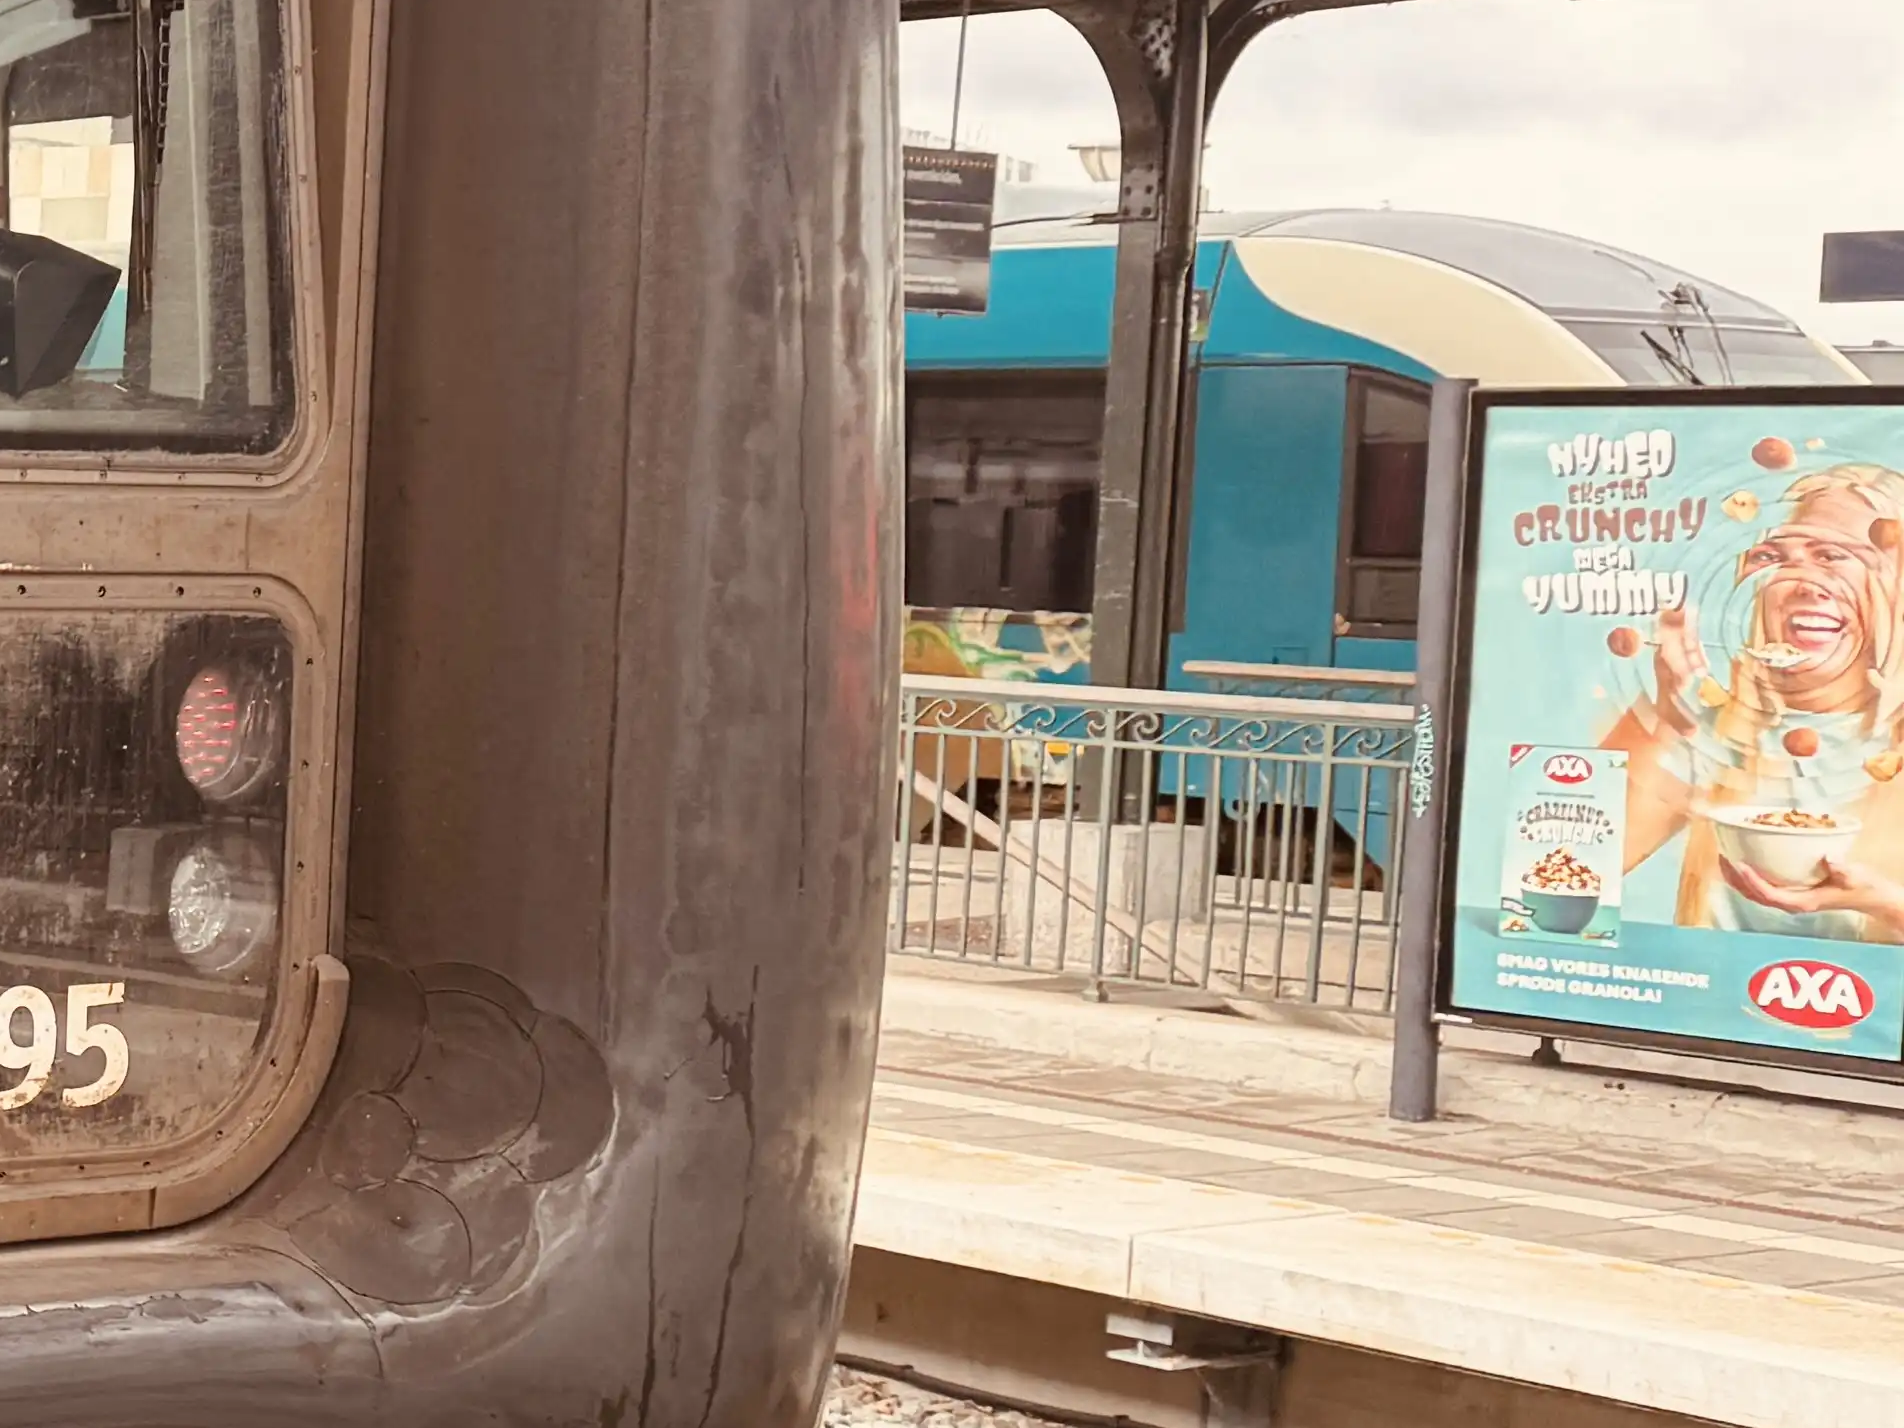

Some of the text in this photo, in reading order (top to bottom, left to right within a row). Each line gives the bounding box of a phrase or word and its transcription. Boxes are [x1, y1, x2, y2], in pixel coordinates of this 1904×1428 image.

[1547, 429, 1675, 477] NYHED
[1567, 477, 1648, 505] EKSTRA
[1513, 496, 1707, 546] CRUNCHY
[1522, 569, 1688, 615] YUMMY
[1545, 755, 1590, 779] AXA
[1496, 952, 1548, 971] SMAG
[1757, 965, 1863, 1018] AXA
